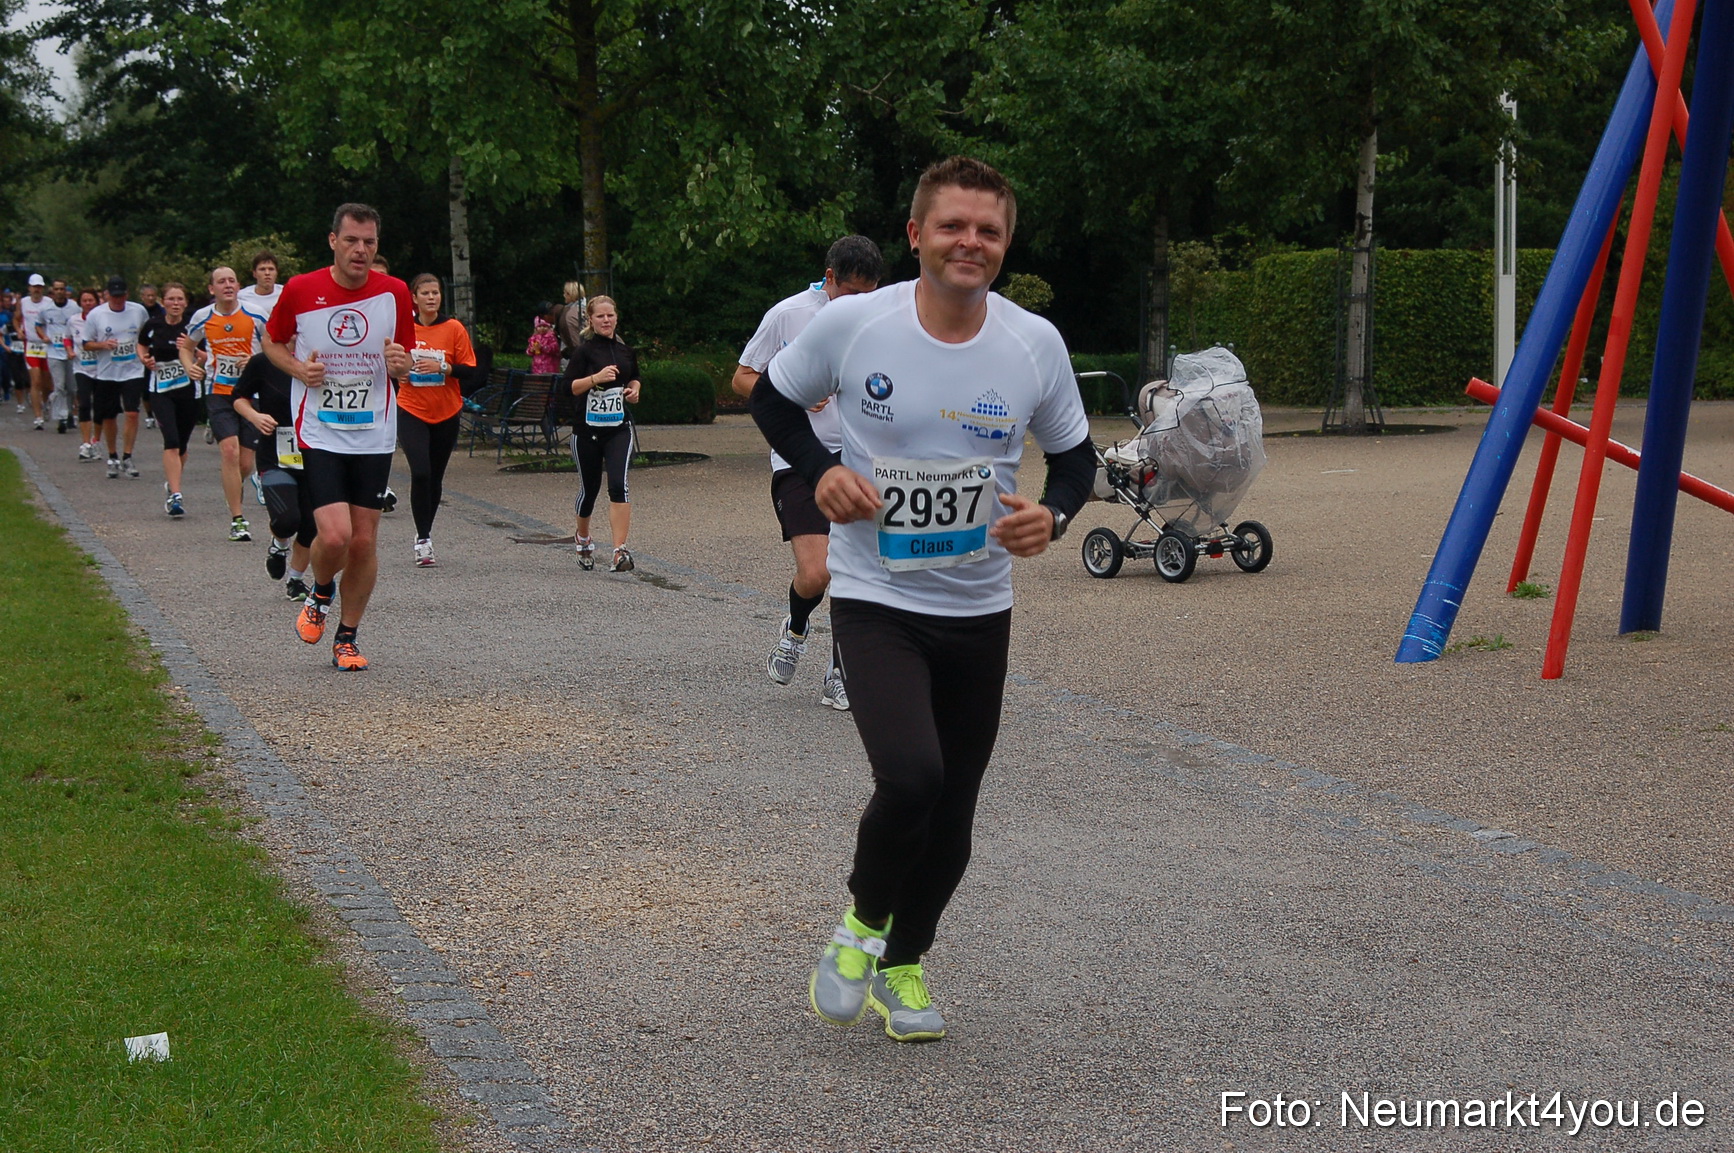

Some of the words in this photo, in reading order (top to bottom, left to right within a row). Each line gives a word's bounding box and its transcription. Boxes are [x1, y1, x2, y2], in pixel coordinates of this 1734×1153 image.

[158, 366, 185, 380] 2525
[323, 389, 369, 409] 2127
[591, 397, 622, 412] 2476
[861, 398, 895, 416] PARTL
[337, 414, 355, 422] Willi
[861, 408, 894, 423] Neumarkt
[940, 409, 960, 422] 14.
[875, 467, 914, 481] PARTL
[916, 470, 974, 482] Neumarkt
[883, 484, 984, 529] 2937
[910, 539, 954, 555] Claus
